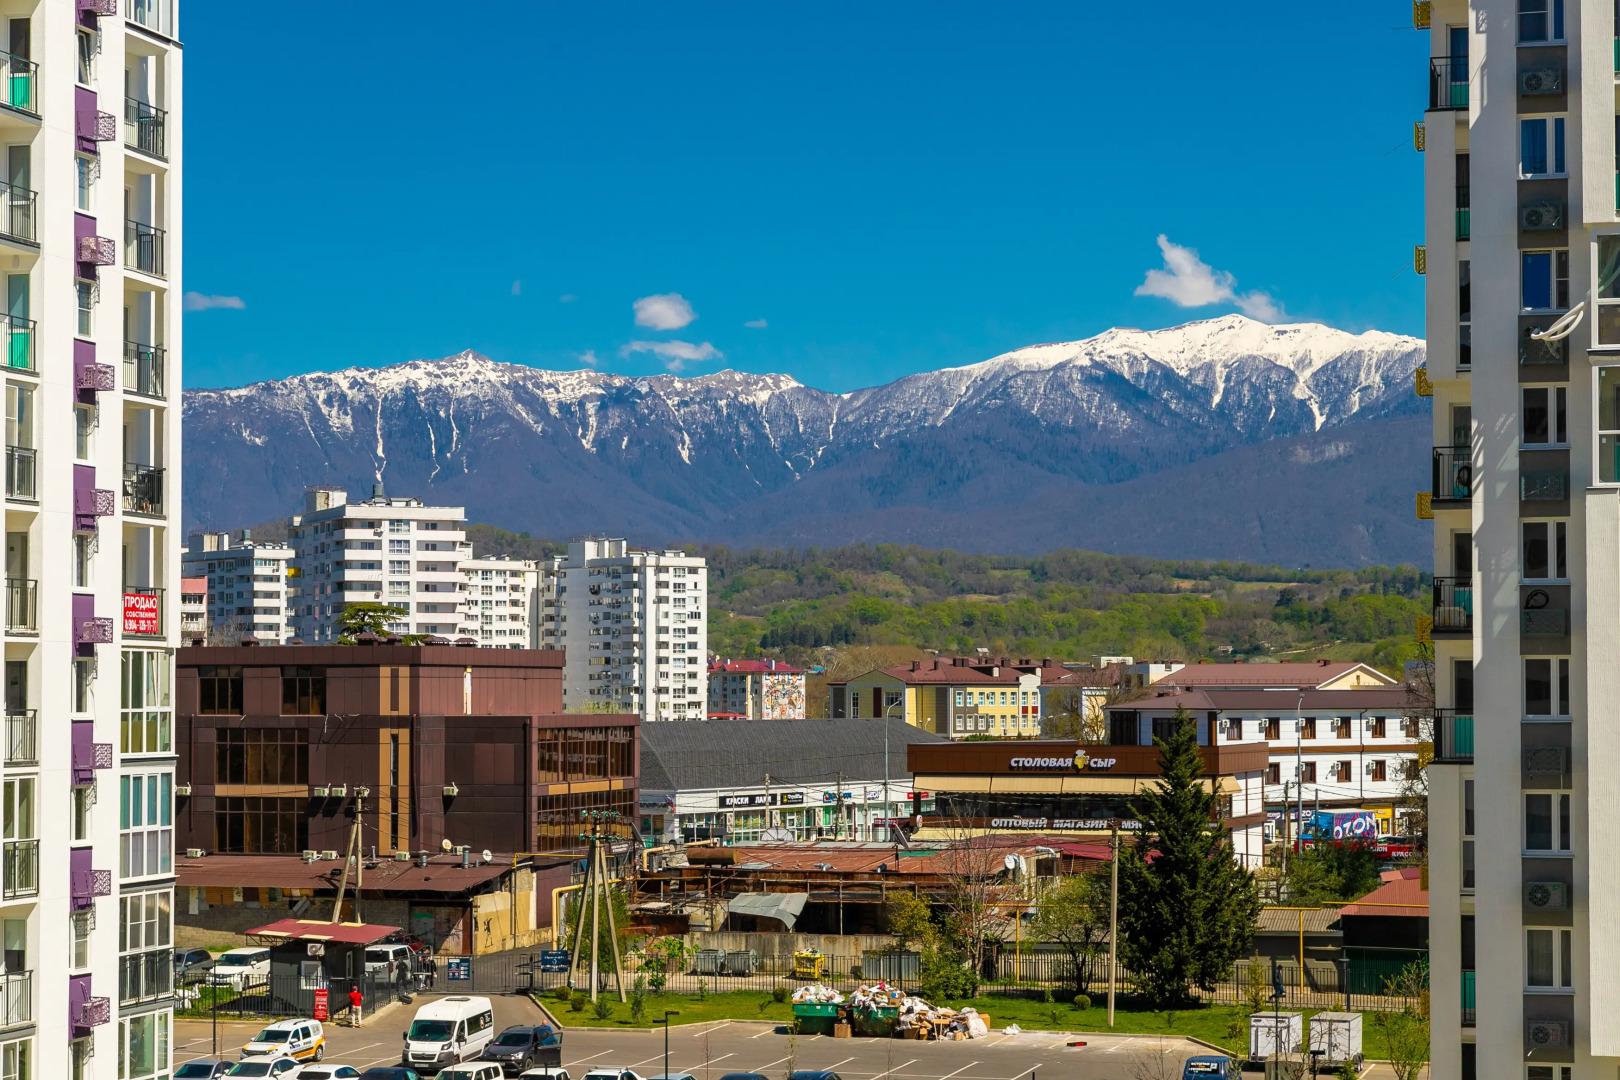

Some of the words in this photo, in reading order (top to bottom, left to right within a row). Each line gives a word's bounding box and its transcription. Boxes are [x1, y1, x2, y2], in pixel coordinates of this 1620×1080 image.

[124, 596, 158, 610] ПРОДАЮ
[1010, 757, 1073, 767] СТОЛОВАЯ
[1089, 758, 1117, 768] СЫР
[725, 797, 749, 806] КРАСКИ
[991, 817, 1048, 828] ОПТОВЫЙ
[1053, 819, 1108, 829] МАГАЗИН
[1333, 814, 1375, 839] OZON
